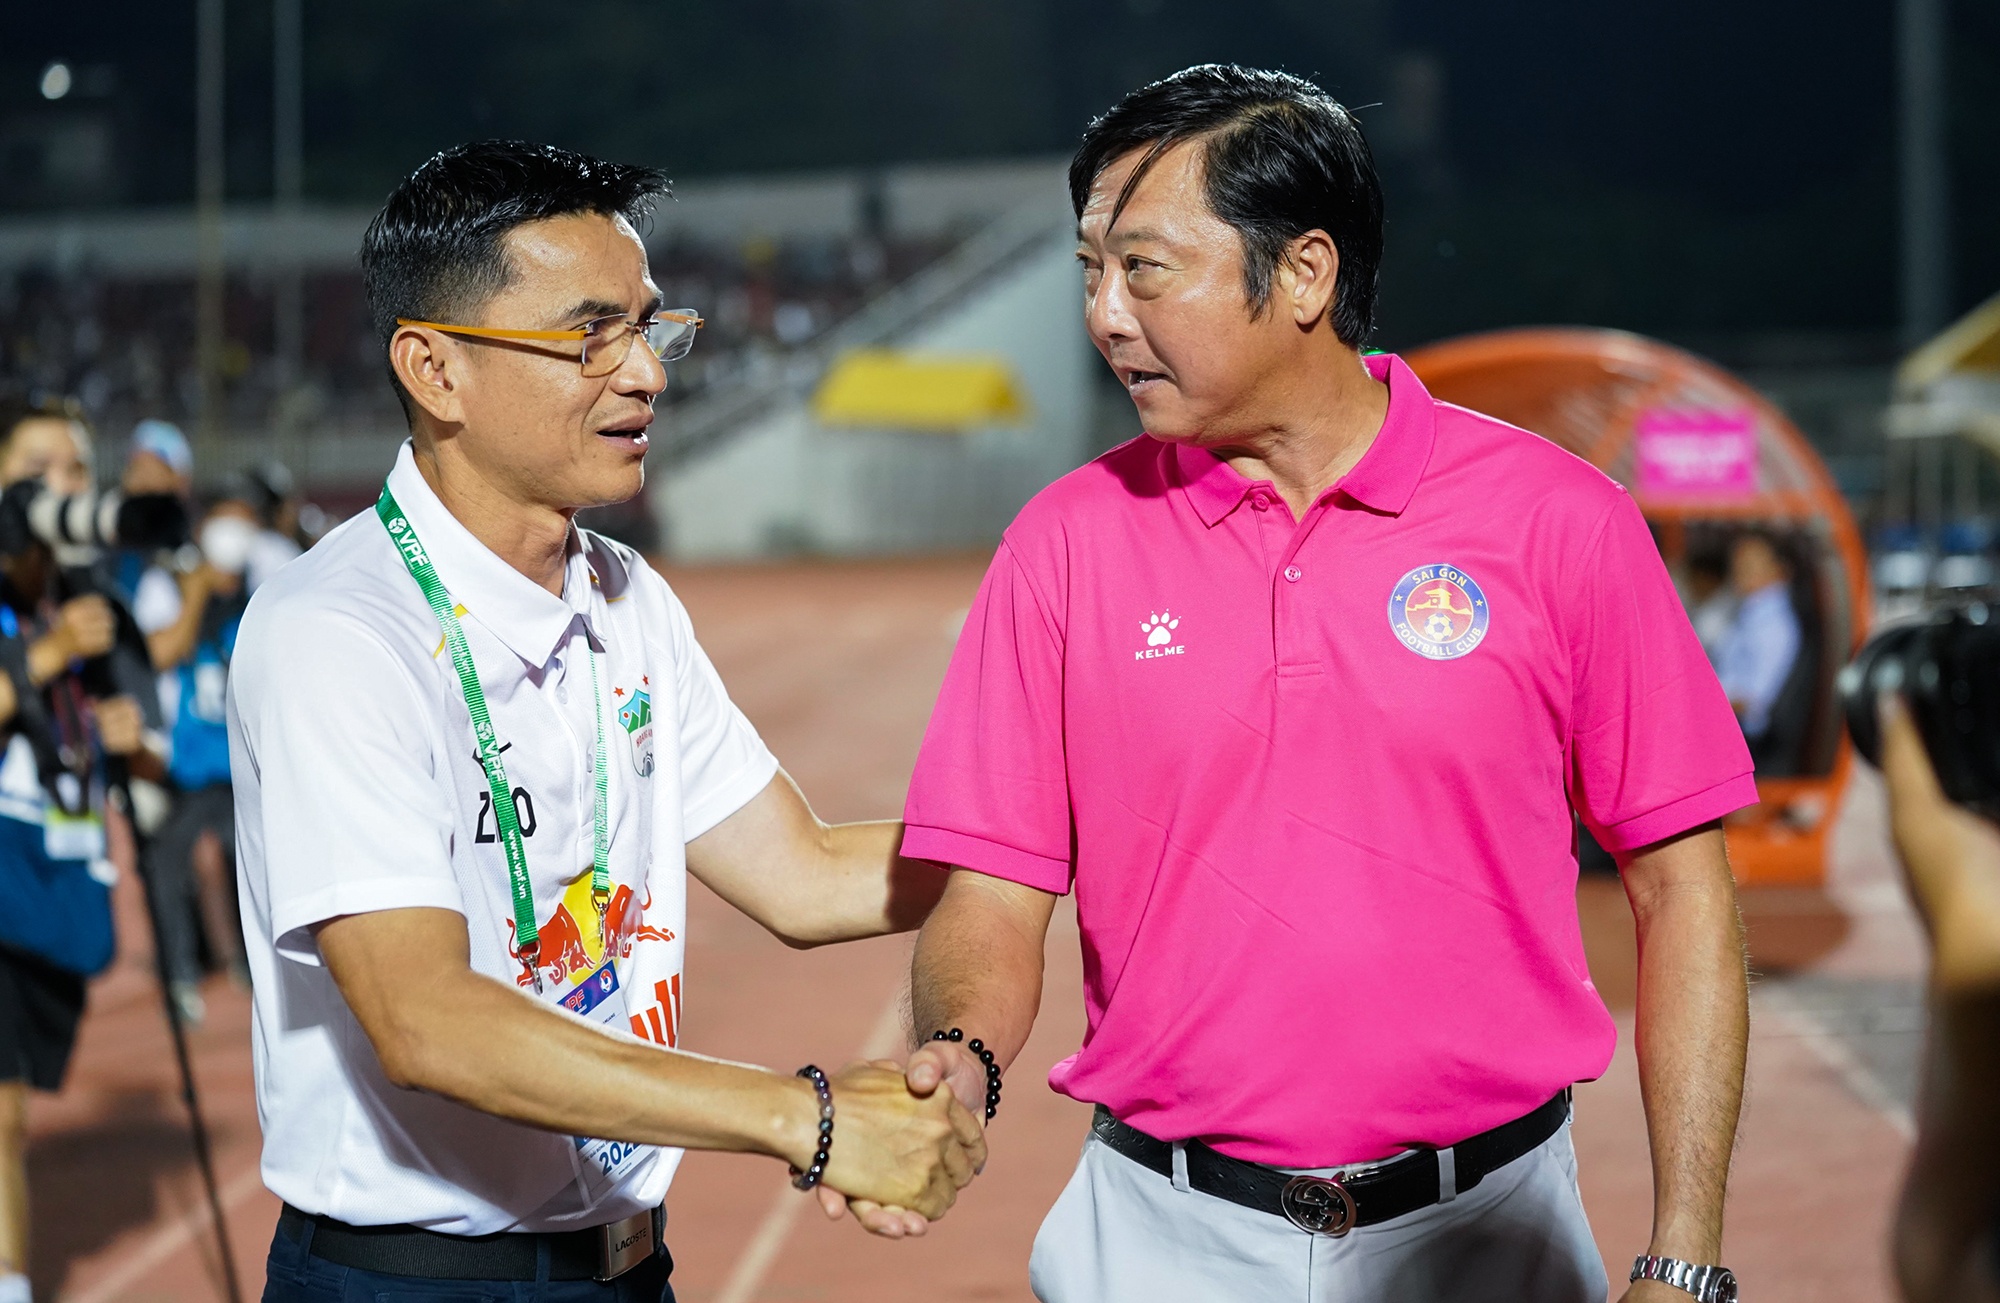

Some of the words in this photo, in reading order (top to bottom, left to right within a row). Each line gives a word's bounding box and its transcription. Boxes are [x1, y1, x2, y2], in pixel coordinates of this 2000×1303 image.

[399, 529, 430, 567] VPF
[1412, 569, 1434, 584] SAI
[1439, 568, 1468, 587] GON
[1135, 645, 1185, 661] KELME
[1396, 622, 1453, 656] FOOTBALL
[1456, 627, 1482, 652] CLUB
[484, 740, 507, 783] VPF
[507, 829, 527, 899] www.vpf.vn
[599, 1141, 640, 1176] 202
[615, 1228, 647, 1253] LACOSTE
